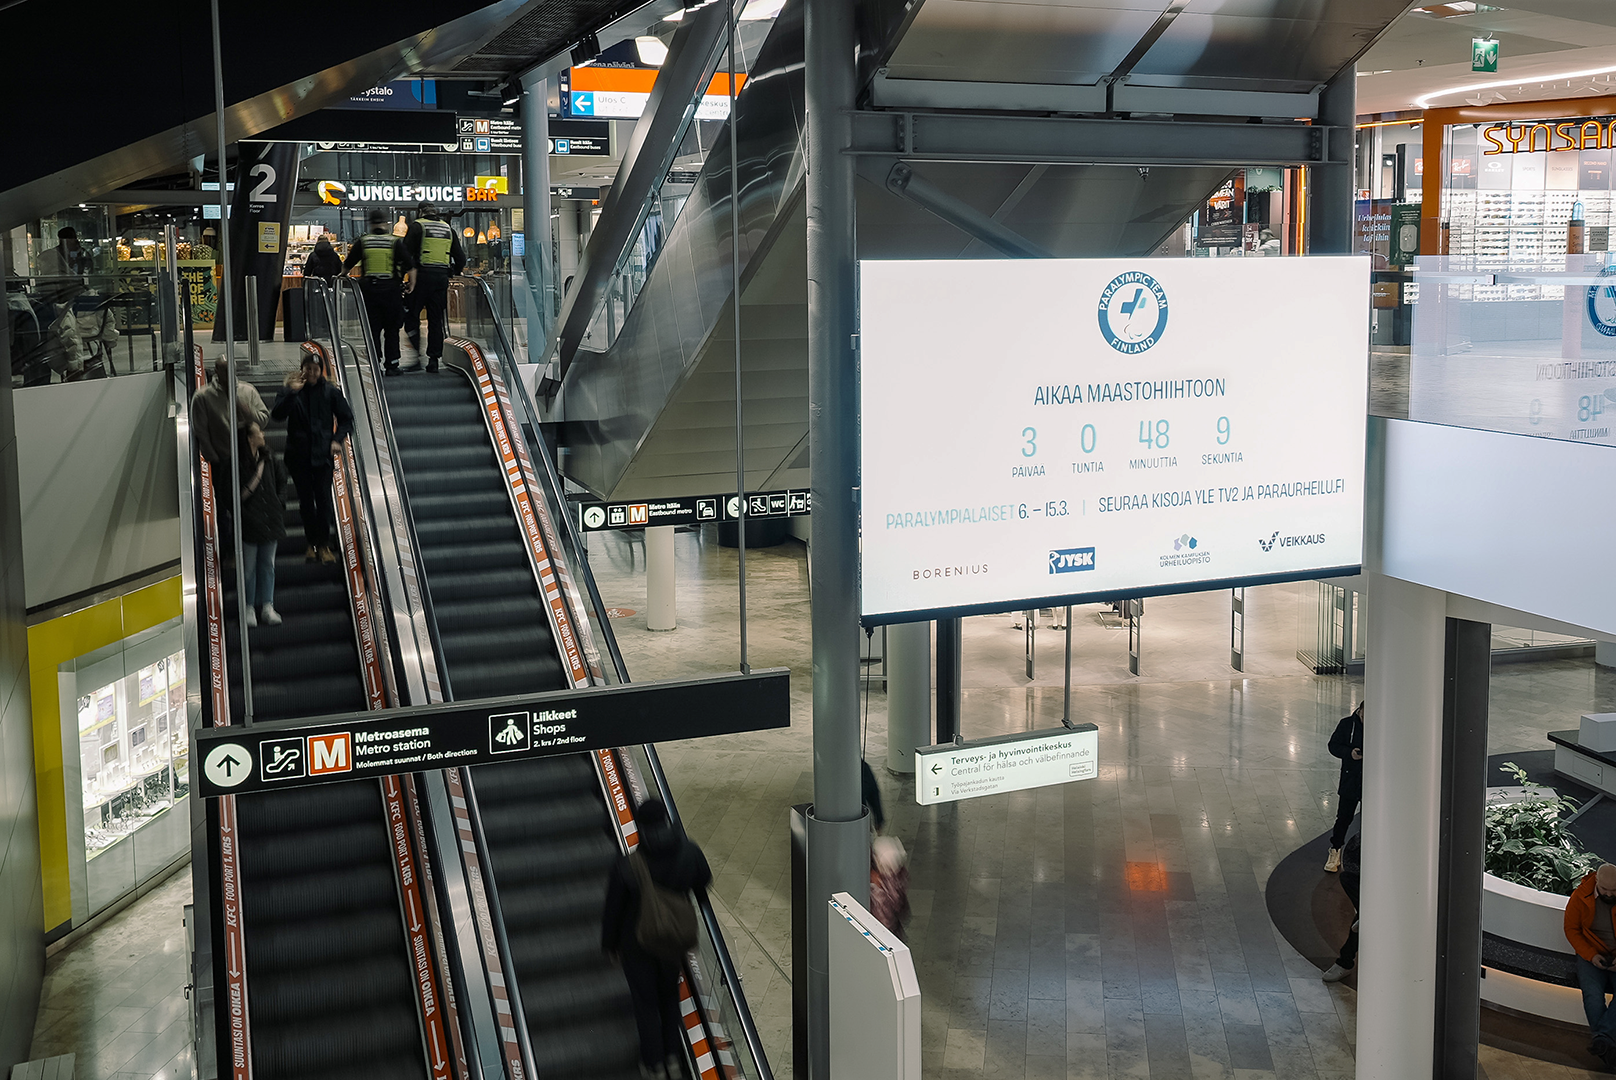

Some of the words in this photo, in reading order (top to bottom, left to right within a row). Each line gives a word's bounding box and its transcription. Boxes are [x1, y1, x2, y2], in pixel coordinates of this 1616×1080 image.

[598, 96, 618, 104] Ulos
[619, 96, 626, 104] C
[476, 121, 488, 133] M
[249, 163, 278, 203] 2
[348, 185, 411, 202] JUNGLE
[415, 185, 463, 202] JUICE
[466, 186, 499, 202] BAR
[1099, 271, 1151, 310] PARALYMPIC
[1149, 279, 1168, 310] TEAM
[1110, 336, 1156, 354] FINLAND
[1034, 384, 1083, 405] AIKAA
[1087, 377, 1226, 403] MAASTOHIIHTOON
[491, 409, 500, 421] KFC
[501, 442, 511, 455] KRS
[1021, 426, 1038, 458] 3
[1080, 423, 1097, 454] 0
[1138, 418, 1170, 450] 48
[1216, 416, 1231, 445] 9
[1072, 461, 1104, 474] TUNTIA
[1129, 456, 1178, 470] MINUUTTIA
[1201, 452, 1243, 465] SEKUNTIA
[771, 499, 785, 509] WC
[1098, 493, 1149, 513] SEURAA
[1152, 490, 1192, 508] KISOJA
[1194, 488, 1215, 505] YLE
[1218, 486, 1239, 503] TV2
[1241, 485, 1255, 502] JA
[1257, 478, 1345, 500] PARAURHEILU.FI
[203, 499, 212, 514] KFC
[520, 500, 531, 514] KFC
[630, 505, 648, 524] M
[648, 508, 677, 517] Eastbound
[886, 504, 1016, 530] PARALYMPIALAISET
[1018, 503, 1030, 519] 6.
[1045, 500, 1070, 517] 15.3.
[524, 513, 535, 526] FOOD
[528, 523, 538, 537] PORT
[533, 539, 543, 554] KRS
[1279, 533, 1326, 547] VEIKKAUS
[206, 543, 214, 562] OIKEA
[347, 550, 358, 570] OIKEA
[1057, 552, 1094, 568] JYSK
[1159, 556, 1211, 568] URHEILUOPISTO
[912, 564, 989, 581] BORENIUS
[356, 599, 366, 616] KFC
[555, 607, 566, 624] KFC
[210, 622, 219, 637] KRS
[360, 616, 369, 631] FOOD
[560, 623, 571, 638] FOOD
[211, 642, 220, 658] PORT
[564, 635, 575, 650] PORT
[212, 656, 221, 671] FOOD
[365, 647, 375, 664] KRS
[570, 654, 581, 671] KRS
[212, 672, 222, 691] KFC
[533, 709, 577, 723] Liikkeet
[355, 727, 430, 743] Metroasema
[533, 724, 566, 736] Shops
[355, 743, 391, 757] Metro
[392, 739, 431, 752] station
[533, 740, 541, 748] 2.
[541, 739, 552, 747] krs
[556, 737, 570, 745] 2nd
[313, 737, 347, 770] M
[356, 758, 394, 769] Molemmat
[394, 754, 422, 765] suunnat
[427, 751, 444, 761] Both
[444, 748, 478, 759] directions
[951, 754, 987, 767] Terveys-
[988, 751, 997, 761] ja
[998, 741, 1072, 760] hyvinvointikeskus
[602, 755, 614, 772] FOOD
[951, 764, 981, 777] Central
[982, 763, 995, 773] för
[996, 758, 1017, 770] hälsa
[1018, 756, 1034, 767] och
[1035, 748, 1090, 765] välbefinnande
[607, 769, 620, 787] PORT
[988, 775, 1005, 783] kautta
[612, 785, 621, 795] 1.
[959, 783, 999, 795] Verkstadsgatan
[390, 800, 402, 821] KFC
[614, 793, 627, 812] KRS
[394, 822, 405, 841] FOOD
[222, 836, 232, 856] KRS
[397, 838, 409, 858] PORT
[223, 856, 233, 864] 1.
[400, 857, 410, 867] 1.
[224, 863, 234, 883] PORT
[401, 864, 413, 886] KRS
[469, 865, 480, 884] KRS
[225, 882, 235, 902] FOOD
[226, 903, 237, 928] KFC
[413, 934, 428, 971] SUUNTASI
[484, 934, 497, 958] KFC
[419, 968, 431, 983] ON
[230, 982, 242, 1017] OIKEA
[421, 981, 436, 1018] OIKEA
[232, 1017, 243, 1030] ON
[233, 1029, 246, 1069] SUUNTASI
